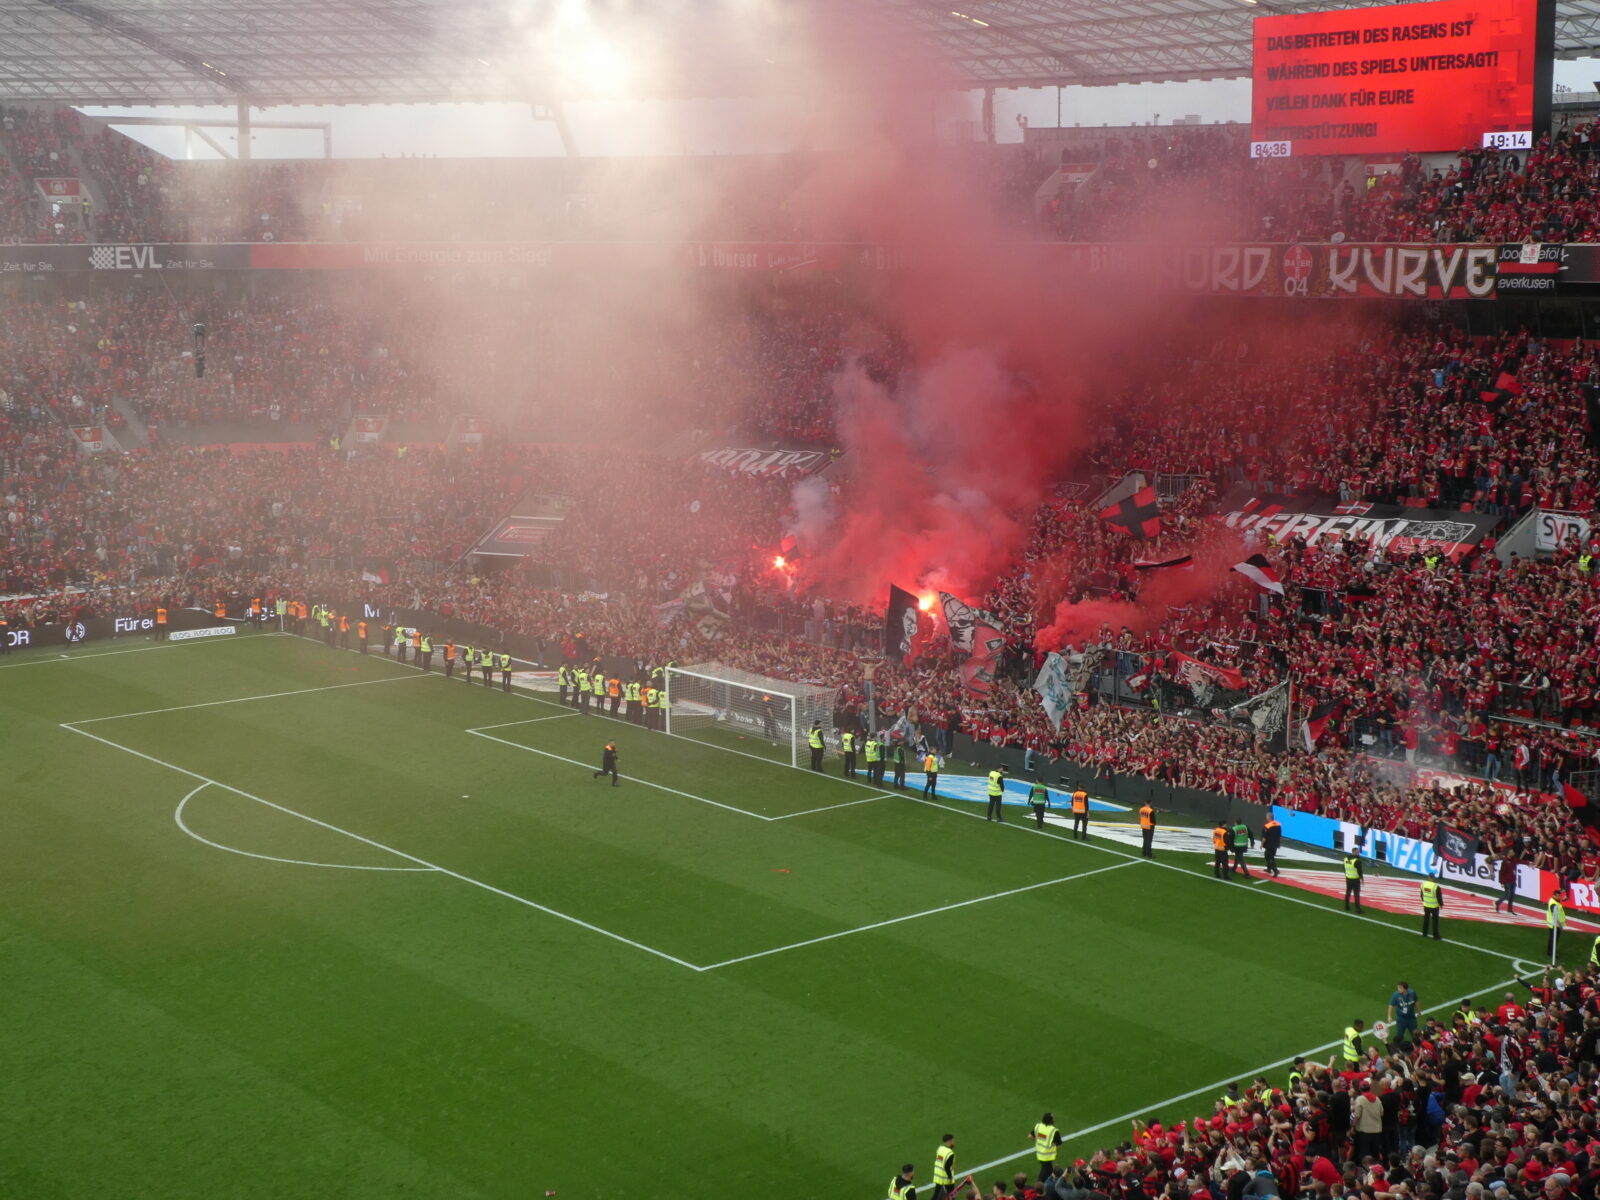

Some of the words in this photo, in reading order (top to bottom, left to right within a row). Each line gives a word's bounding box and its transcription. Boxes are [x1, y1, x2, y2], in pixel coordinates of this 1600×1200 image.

[1267, 35, 1293, 51] DAS
[1294, 31, 1360, 49] BETRETEN
[1363, 28, 1389, 44] DES
[1391, 23, 1447, 42] RASENS
[1450, 20, 1473, 37] IST
[1267, 61, 1330, 81] WÄHREND
[1333, 59, 1358, 77] DES
[1360, 56, 1407, 76] SPIELS
[1410, 51, 1499, 72] UNTERSAGT!
[1266, 95, 1309, 111] VIELEN
[1311, 93, 1346, 109] DANK
[1349, 89, 1376, 107] FÜR
[1378, 89, 1414, 105] EURE
[1255, 143, 1287, 156] 84:36
[115, 246, 162, 269] EVL
[1329, 247, 1495, 297] KURVE
[1498, 275, 1560, 289] everkusen
[1284, 276, 1309, 296] 04
[115, 617, 138, 633] Für
